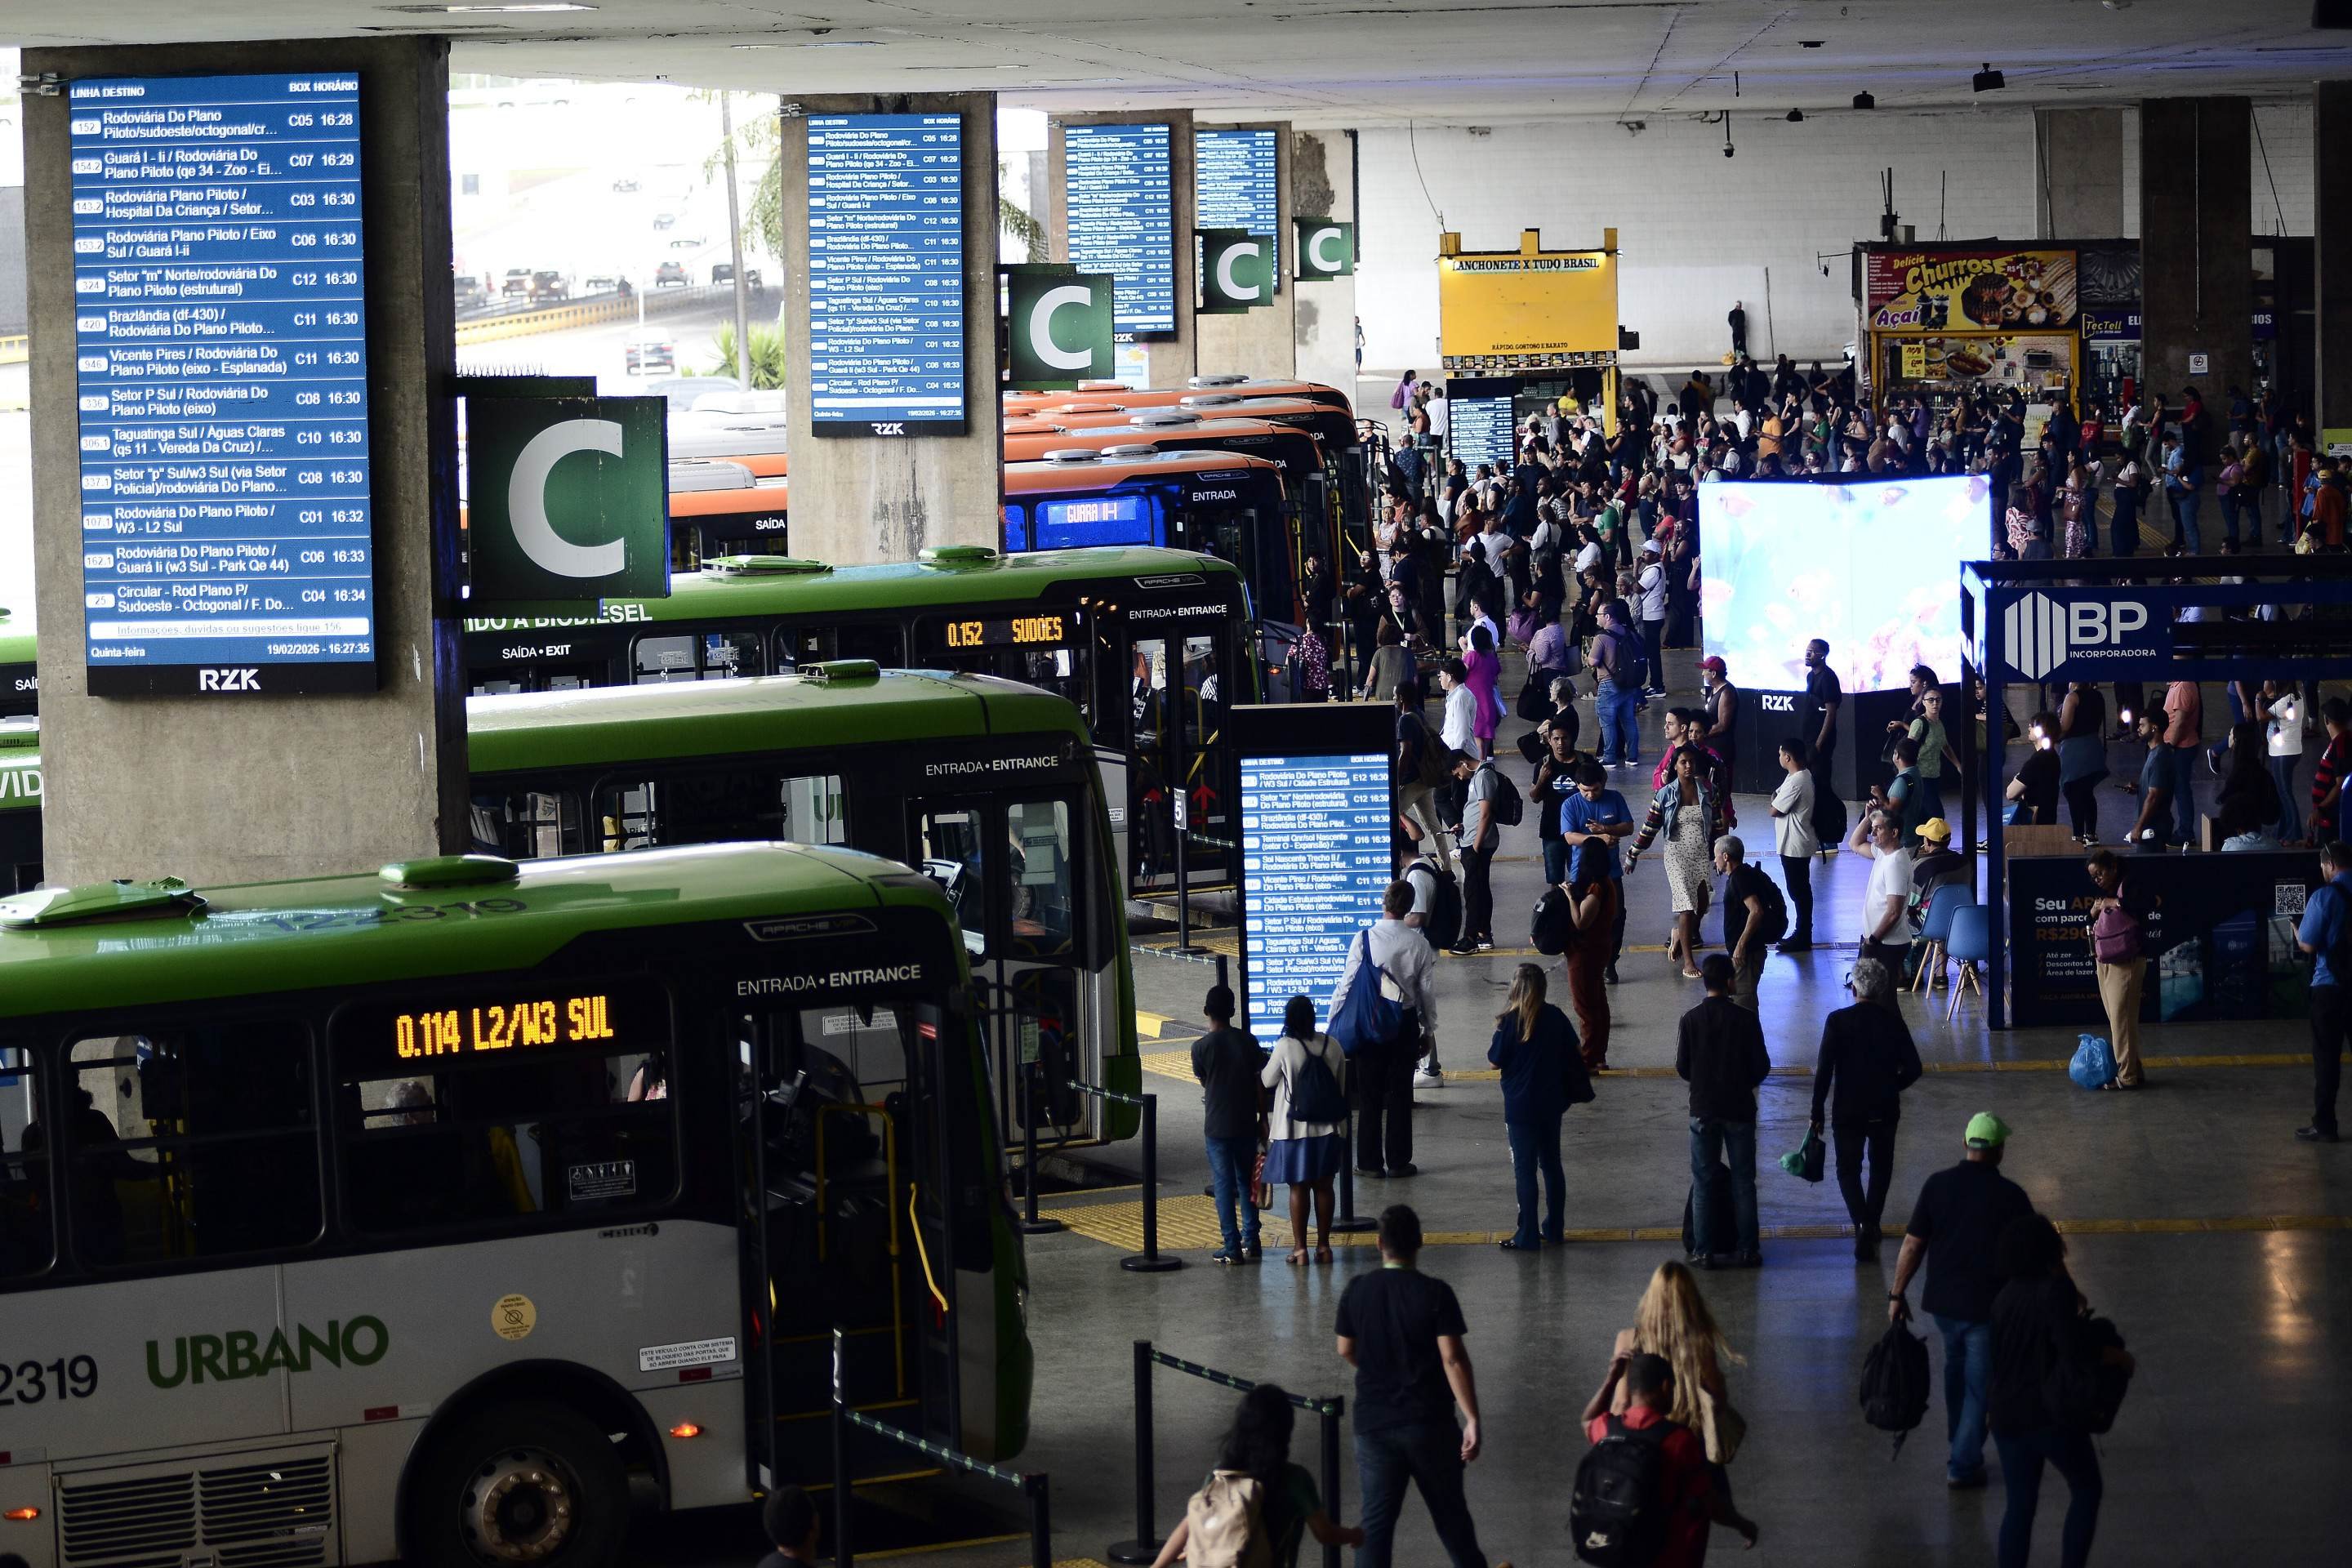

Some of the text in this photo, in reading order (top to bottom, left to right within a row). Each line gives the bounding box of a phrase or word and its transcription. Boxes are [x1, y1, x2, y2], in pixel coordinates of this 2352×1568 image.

[70, 86, 145, 98] LINHA DESTINO
[288, 80, 358, 92] BOX HORÁRIO
[103, 109, 221, 124] Rodoviária Do Plano
[288, 113, 353, 127] C05 16:28
[78, 122, 96, 132] 152
[939, 134, 957, 142] 16:28
[289, 154, 354, 167] C07 16:29
[290, 193, 354, 206] C03 16:30
[291, 233, 356, 246] C06 16:30
[1308, 227, 1342, 272] C
[1453, 258, 1599, 270] LANCHONETE X TUDO BRASIL
[107, 270, 139, 283] Setor
[164, 267, 256, 281] Norte/rodoviária
[259, 267, 277, 278] Do
[1216, 242, 1259, 301] C
[1905, 259, 1993, 292] Churros
[292, 272, 357, 285] C12 16:30
[108, 282, 243, 297] Plano Piloto (estrutural)
[109, 309, 170, 323] Brazlândia
[172, 308, 218, 323] (df-430)
[293, 312, 358, 326] C11 16:30
[1875, 305, 1922, 329] Açaí
[2252, 314, 2272, 324] IOS
[109, 322, 274, 337] Rodoviária Do Plano Piloto...
[1029, 286, 1093, 369] C
[2086, 320, 2122, 330] TecTell
[871, 422, 905, 435] RZK
[1204, 472, 1232, 480] APACHE
[507, 417, 627, 579] C
[1192, 489, 1236, 501] ENTRADA
[755, 519, 786, 530] SAÍDA
[1143, 577, 1180, 586] APACHE
[1129, 604, 1227, 619] ENTRADA ENTRANCE
[2069, 602, 2148, 644] BP
[91, 647, 145, 657] Quinta-feira
[267, 644, 319, 654] 19/02/2026
[328, 642, 369, 653] 16:27:35
[502, 644, 571, 659] SAÍDA EXIT
[2069, 648, 2156, 658] INCORPORADORA
[198, 669, 262, 692] RZK
[1761, 694, 1795, 711] RZK
[926, 755, 1058, 776] ENTRADA ENTRANCE
[1259, 772, 1294, 780] Rodoviária
[1352, 773, 1367, 782] E12
[1353, 795, 1368, 803] C12
[1174, 801, 1183, 822] 5
[2035, 898, 2066, 911] Seu
[2148, 911, 2162, 920] de
[762, 921, 829, 936] APACHE
[737, 964, 920, 996] ENTRADA ENTRANCE
[396, 996, 613, 1058] 0.114 L2/W3 SUL
[145, 1315, 389, 1389] URBANO
